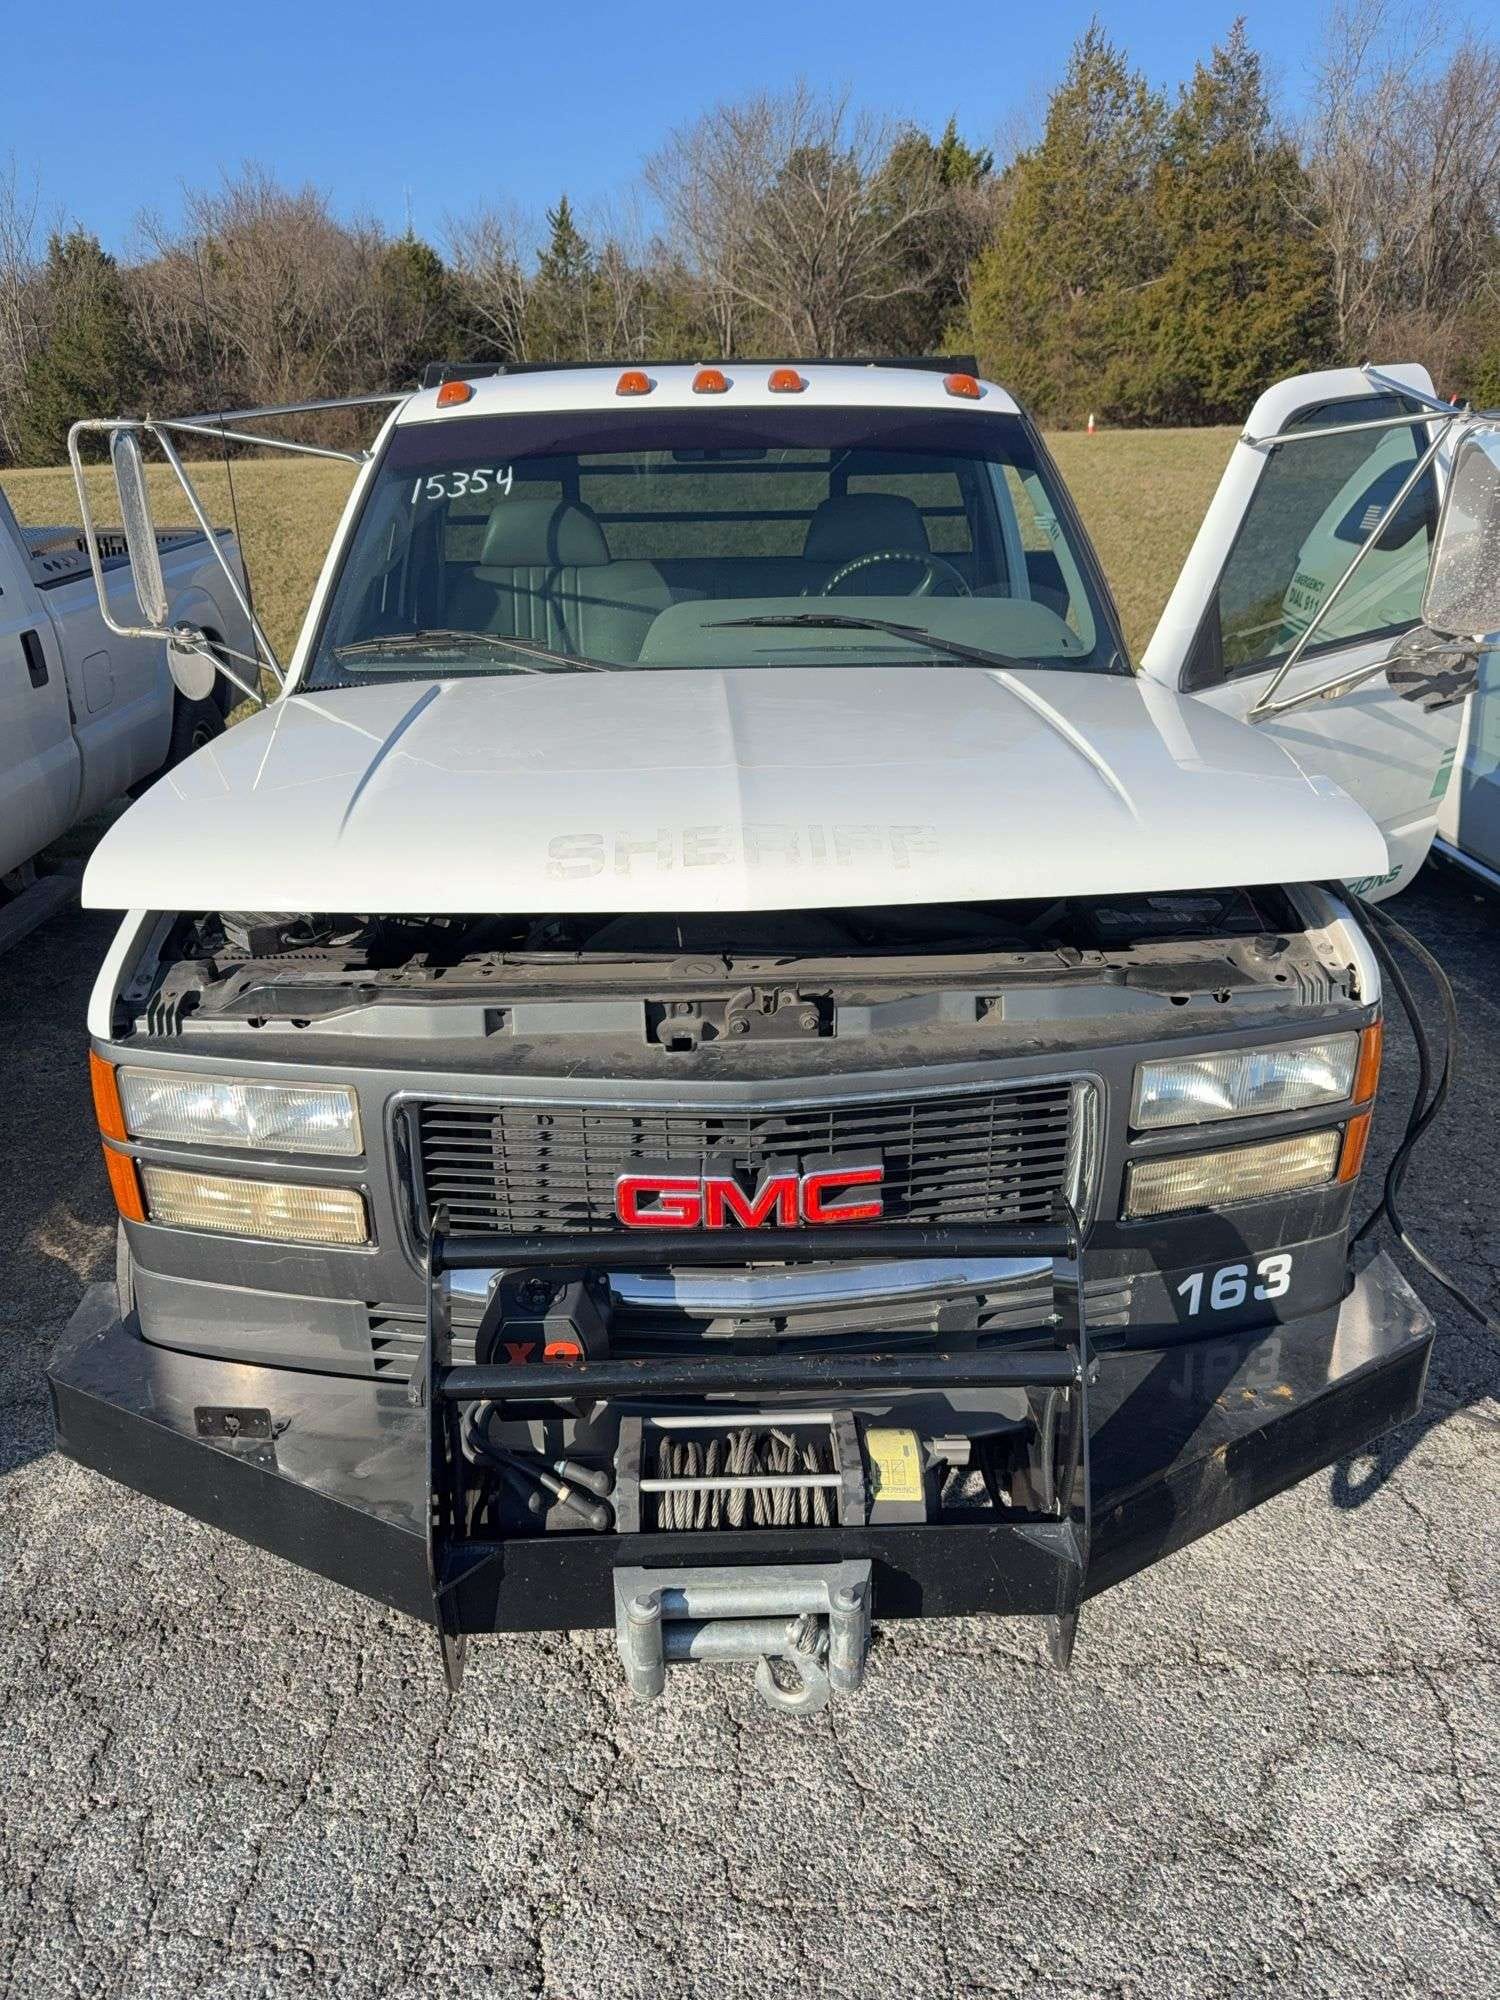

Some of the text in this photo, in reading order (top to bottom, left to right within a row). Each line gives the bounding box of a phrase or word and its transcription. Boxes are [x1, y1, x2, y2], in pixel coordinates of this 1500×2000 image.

[411, 466, 513, 504] 15354
[1288, 587, 1320, 614] DIAL 911
[547, 823, 943, 880] SHERIFF
[614, 1164, 884, 1229] GMC
[1176, 1253, 1293, 1316] 163
